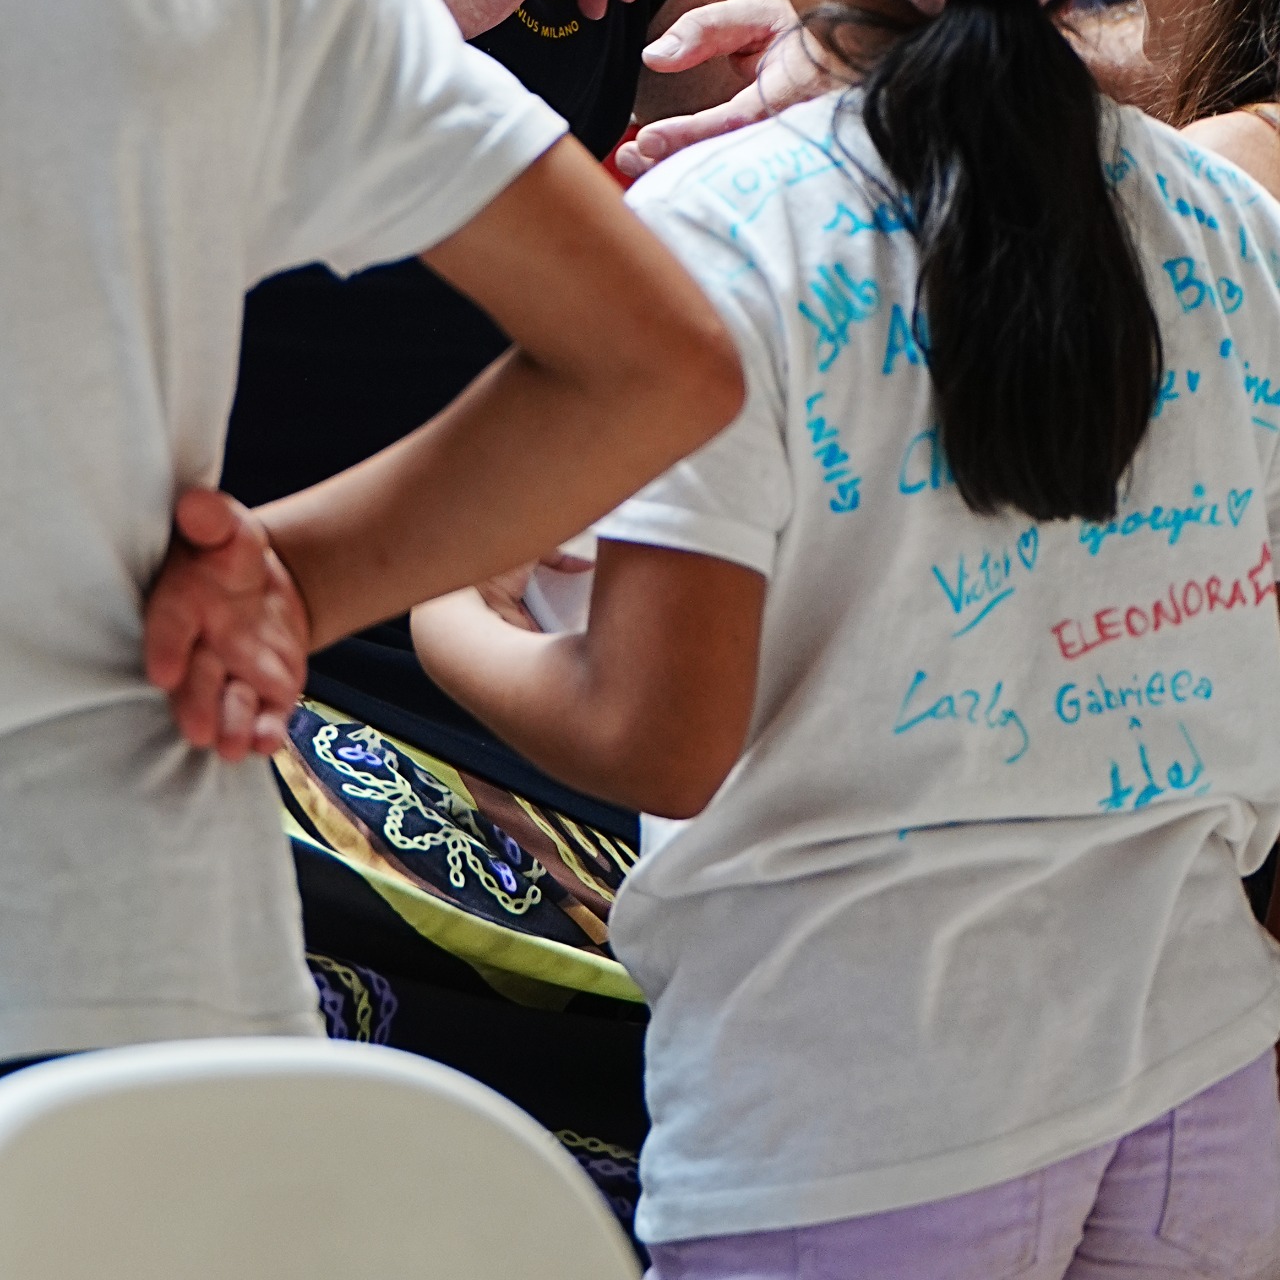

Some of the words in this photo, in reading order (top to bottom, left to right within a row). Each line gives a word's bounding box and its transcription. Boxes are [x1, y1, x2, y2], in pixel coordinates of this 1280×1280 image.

[514, 6, 539, 33] NLUS
[540, 20, 580, 39] MILANO
[1050, 575, 1247, 661] ELEONORA
